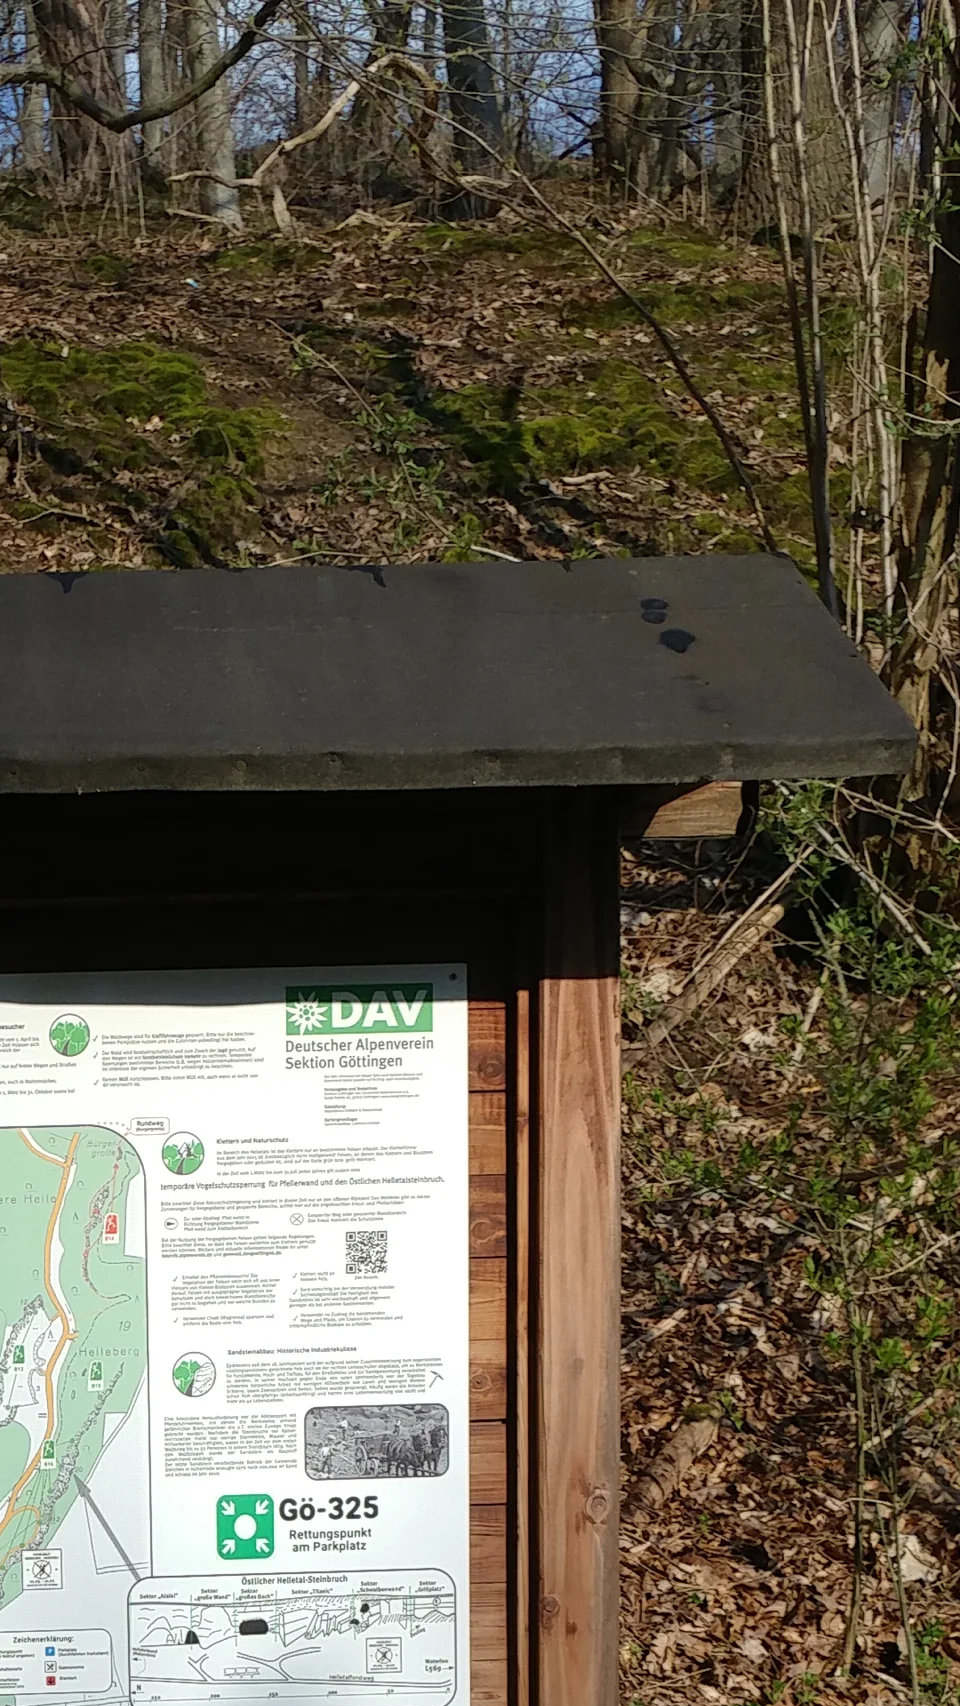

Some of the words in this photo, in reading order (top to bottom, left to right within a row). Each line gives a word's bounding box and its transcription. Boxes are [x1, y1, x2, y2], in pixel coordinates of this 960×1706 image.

[331, 990, 428, 1028] DAV
[286, 1039, 352, 1052] Deutscher
[356, 1037, 434, 1053] Alpenverein
[285, 1056, 334, 1069] Sektion
[339, 1055, 402, 1069] Göttingen
[349, 1177, 380, 1185] Östlichen
[279, 1496, 378, 1520] Gö-325
[290, 1529, 372, 1541] Rettungspunkt
[293, 1542, 310, 1552] am
[313, 1541, 366, 1552] Parkplatz
[242, 1577, 274, 1586] Östlicher
[277, 1575, 348, 1584] Helletal-Steinbruch
